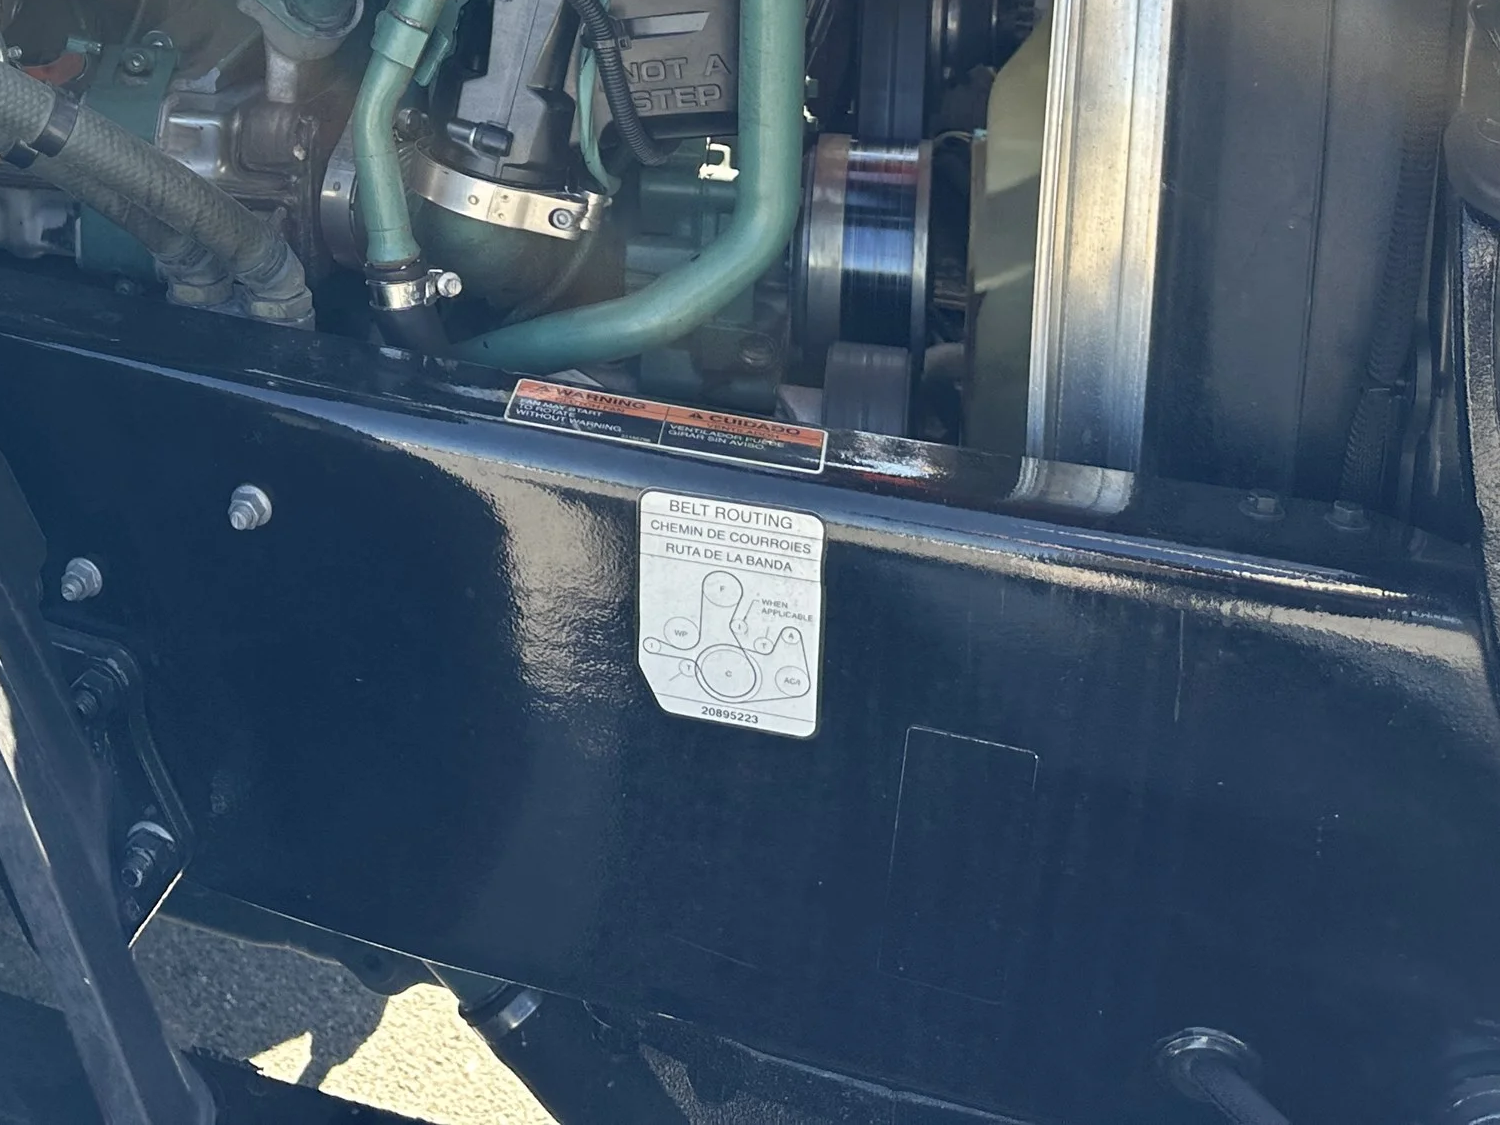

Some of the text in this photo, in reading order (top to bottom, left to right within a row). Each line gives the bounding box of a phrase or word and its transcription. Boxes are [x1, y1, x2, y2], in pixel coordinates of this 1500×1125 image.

[624, 53, 732, 84] NOT A
[631, 83, 722, 111] STEP
[552, 388, 646, 410] WARNING
[515, 409, 567, 423] WITHOUT
[536, 405, 577, 418] ROTATE
[669, 424, 743, 440] VENTILADOR
[709, 415, 801, 436] CUIDADO
[668, 430, 705, 441] GIRAR
[707, 435, 727, 444] SIN
[669, 499, 793, 530] BELT ROUTING
[650, 519, 812, 555] CHEMIN DE COURROIES
[665, 542, 793, 572] RUTA DE LA BANDA
[761, 598, 789, 610] WHEN
[761, 608, 814, 623] APPLICABLE
[674, 629, 689, 638] WP
[700, 706, 759, 724] 20895223
